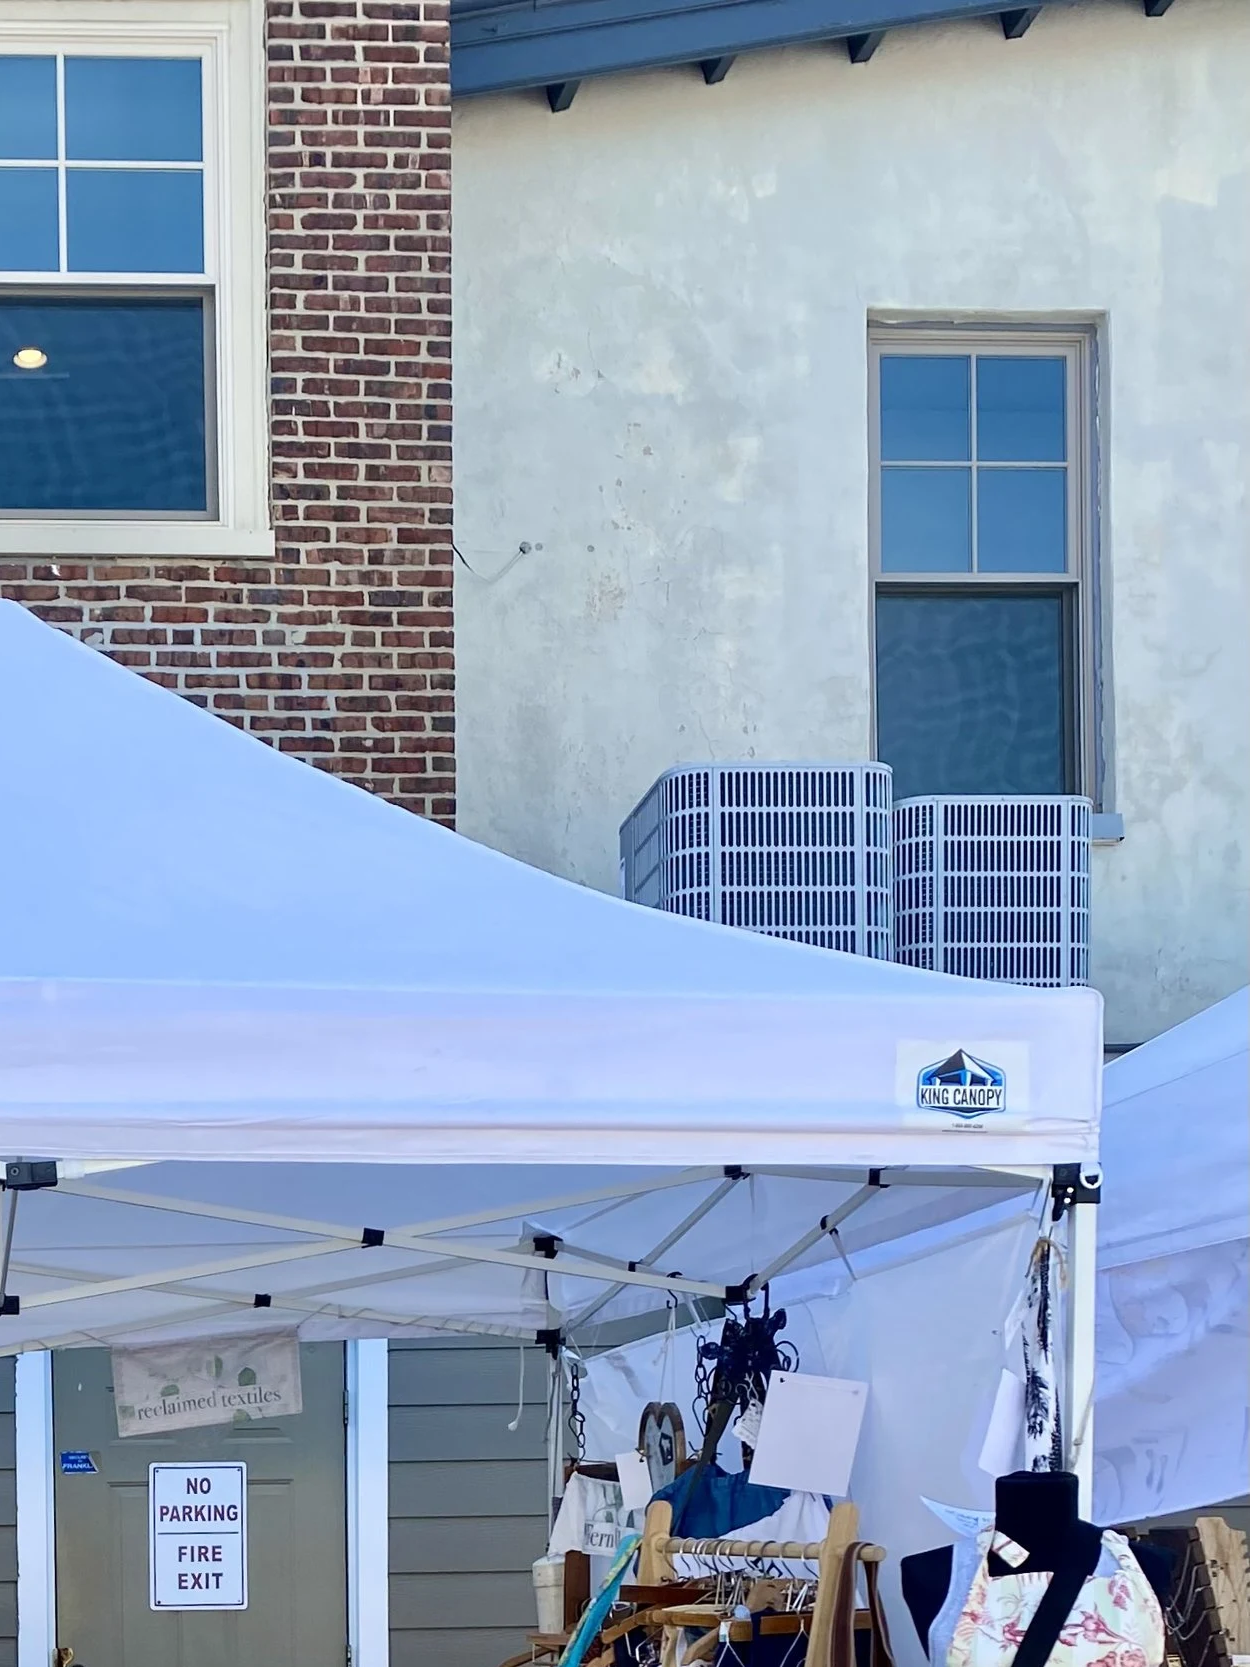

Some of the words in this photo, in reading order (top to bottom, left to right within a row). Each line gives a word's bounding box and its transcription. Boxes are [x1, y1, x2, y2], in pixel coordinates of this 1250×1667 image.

[920, 1088, 950, 1105] KING
[953, 1088, 1003, 1106] CANOPY
[137, 1389, 218, 1421] reclaimed
[221, 1386, 282, 1408] textiles
[186, 1477, 211, 1495] NO
[159, 1504, 238, 1522] PARKING
[584, 1522, 616, 1547] Fern
[178, 1545, 222, 1562] FIRE
[178, 1572, 223, 1590] EXIT
